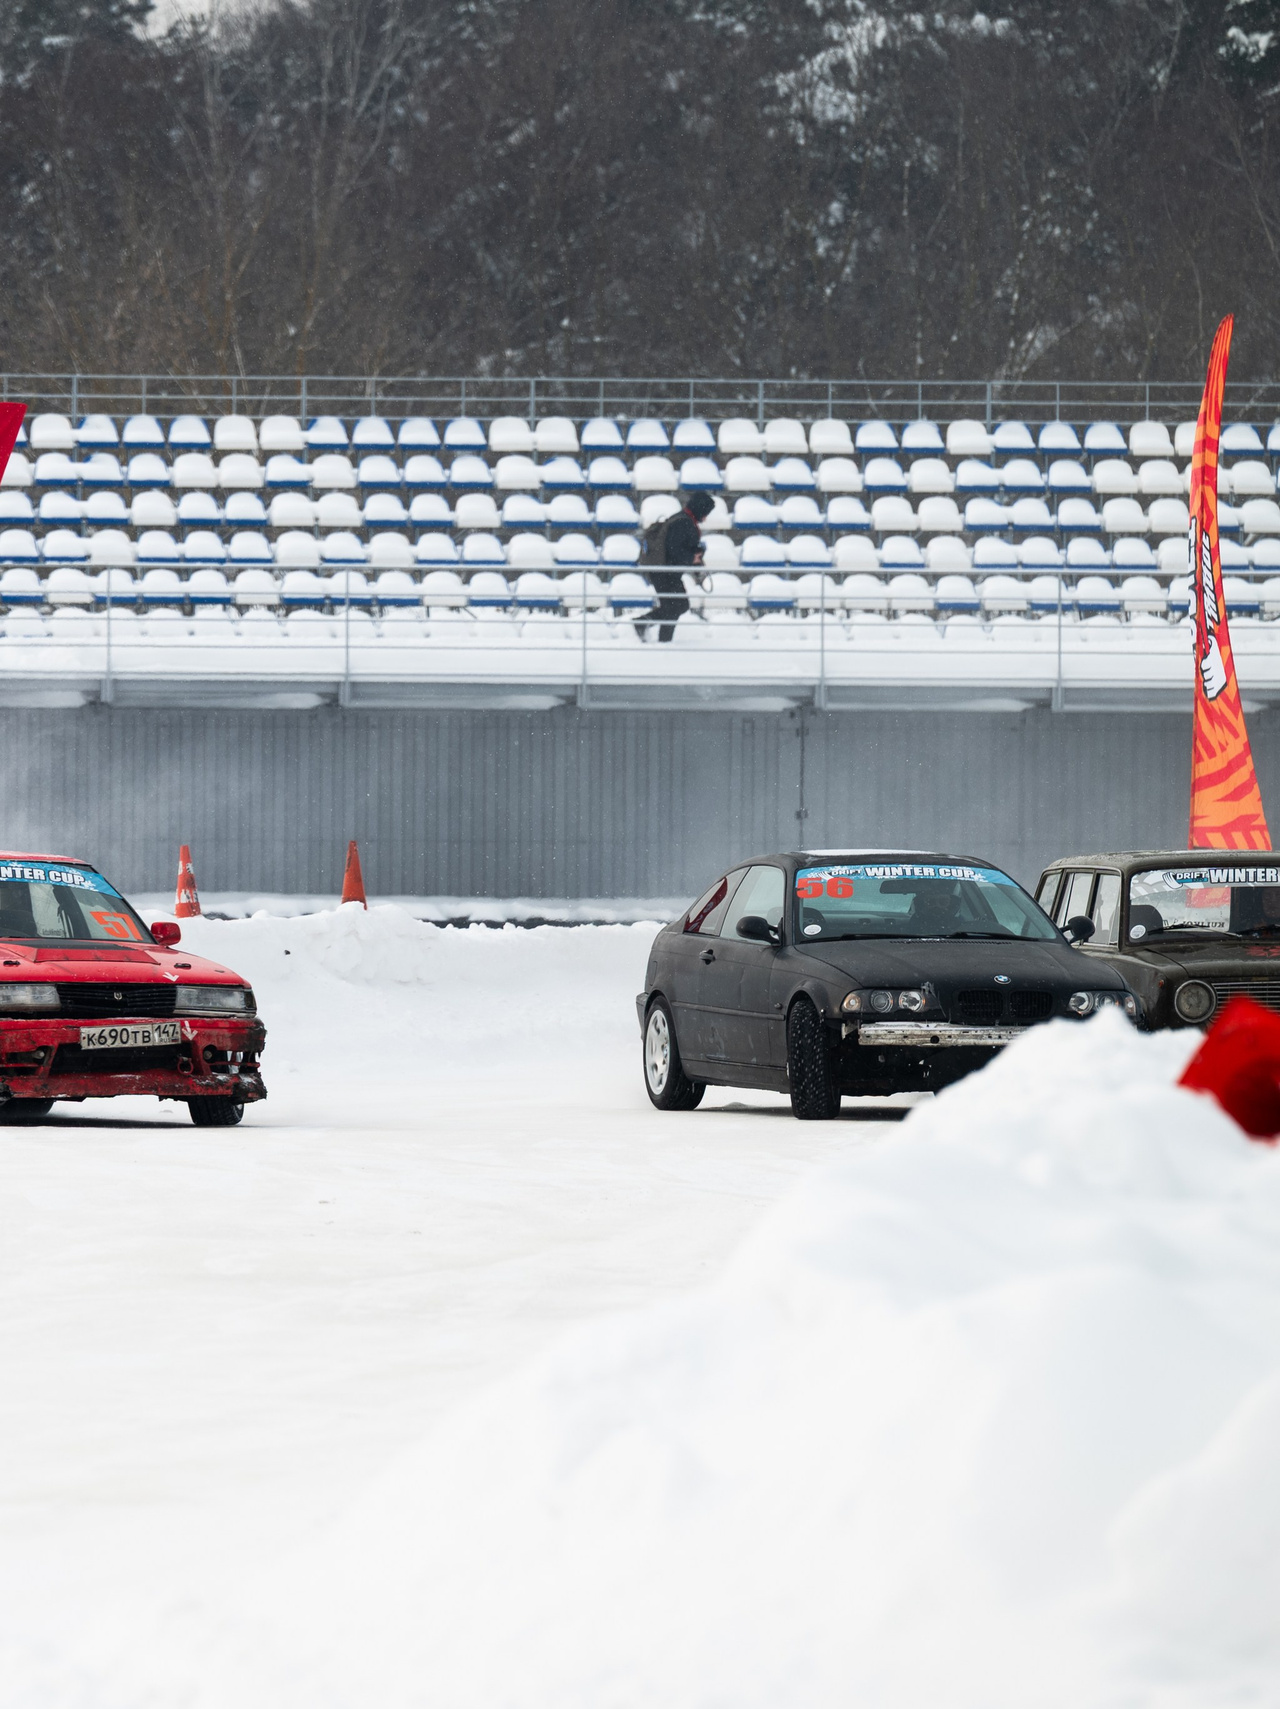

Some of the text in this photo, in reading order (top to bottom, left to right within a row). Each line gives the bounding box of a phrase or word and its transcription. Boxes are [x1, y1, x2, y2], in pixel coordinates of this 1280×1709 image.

[49, 870, 85, 886] CUP
[865, 866, 935, 877] WINTER
[938, 867, 975, 878] CUP
[1176, 871, 1208, 880] DRIFT
[1209, 868, 1277, 883] WINTER
[796, 877, 854, 899] 56
[90, 911, 144, 941] 57
[154, 1023, 176, 1037] 147
